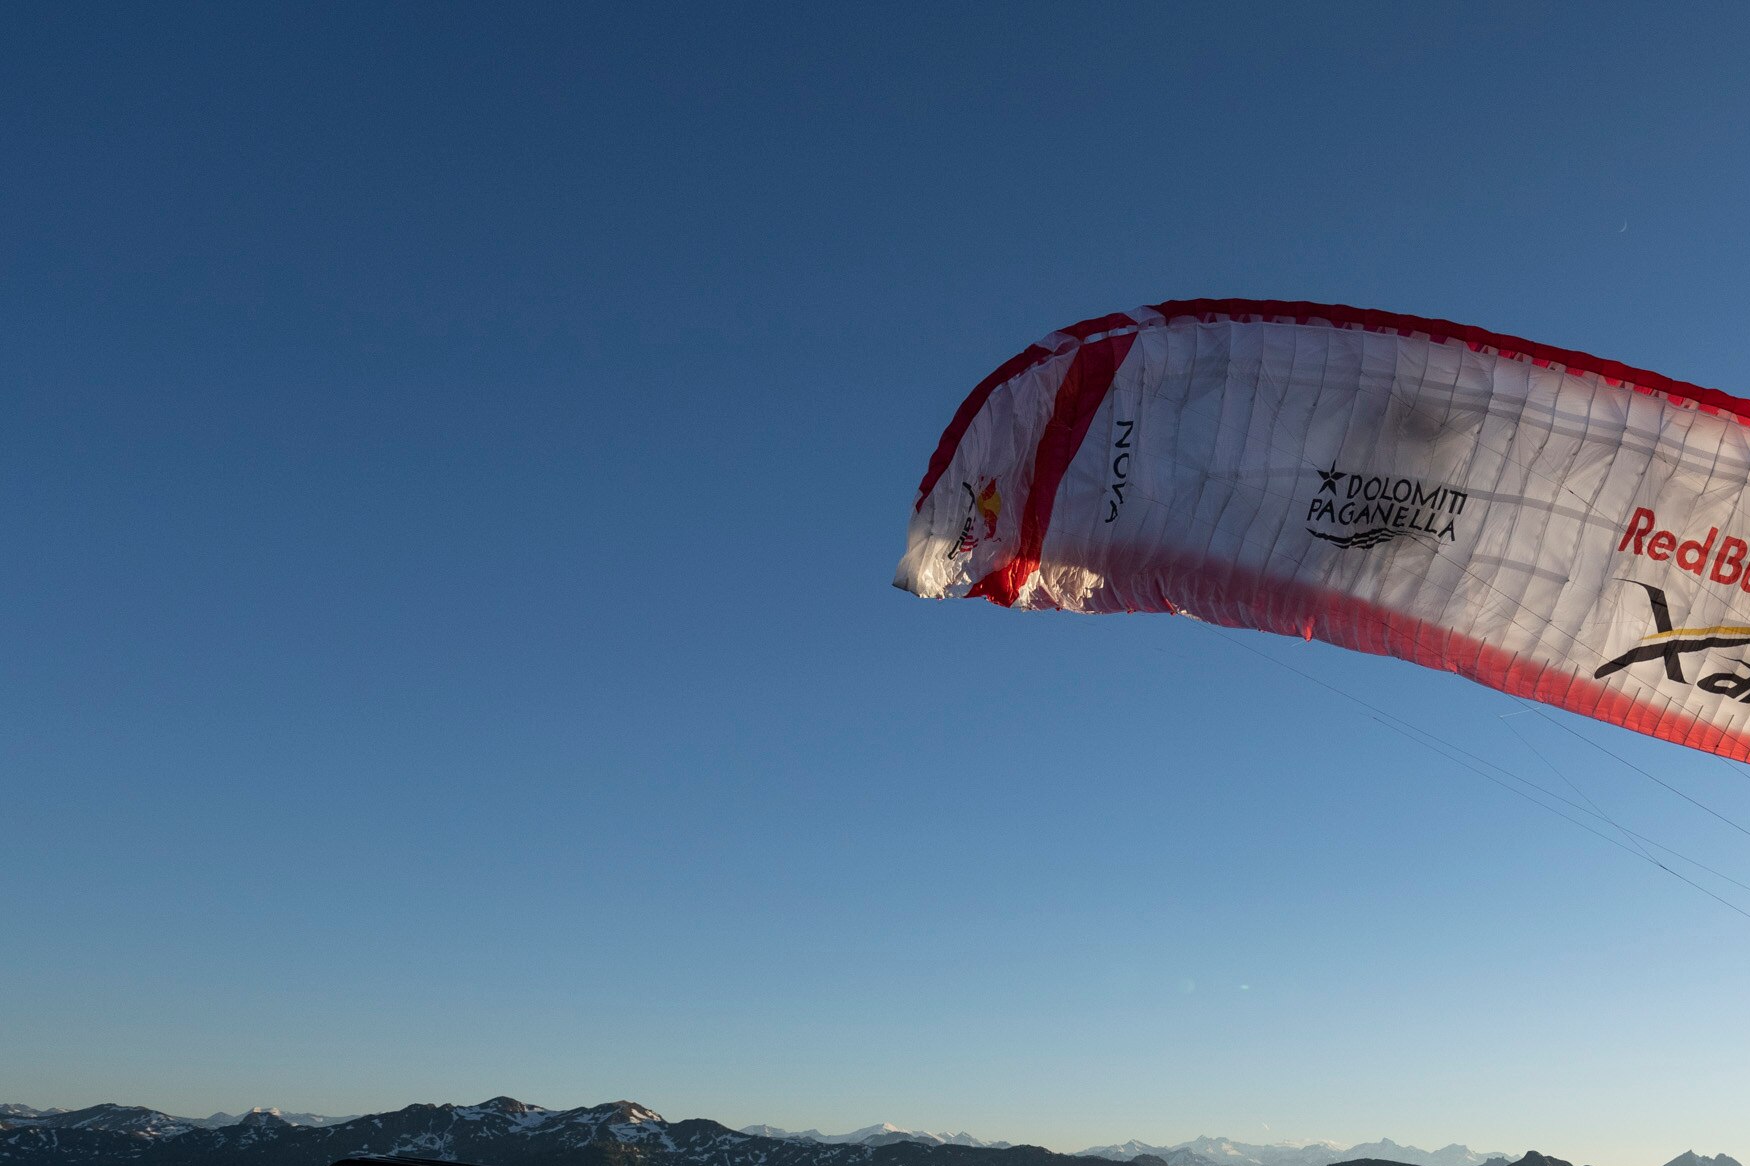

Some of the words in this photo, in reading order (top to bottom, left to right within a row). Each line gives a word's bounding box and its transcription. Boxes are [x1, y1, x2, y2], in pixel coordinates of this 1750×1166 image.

[1347, 474, 1468, 515] DOLOMITI
[1306, 498, 1456, 542] PAGANELLA
[1617, 506, 1719, 577] Red
